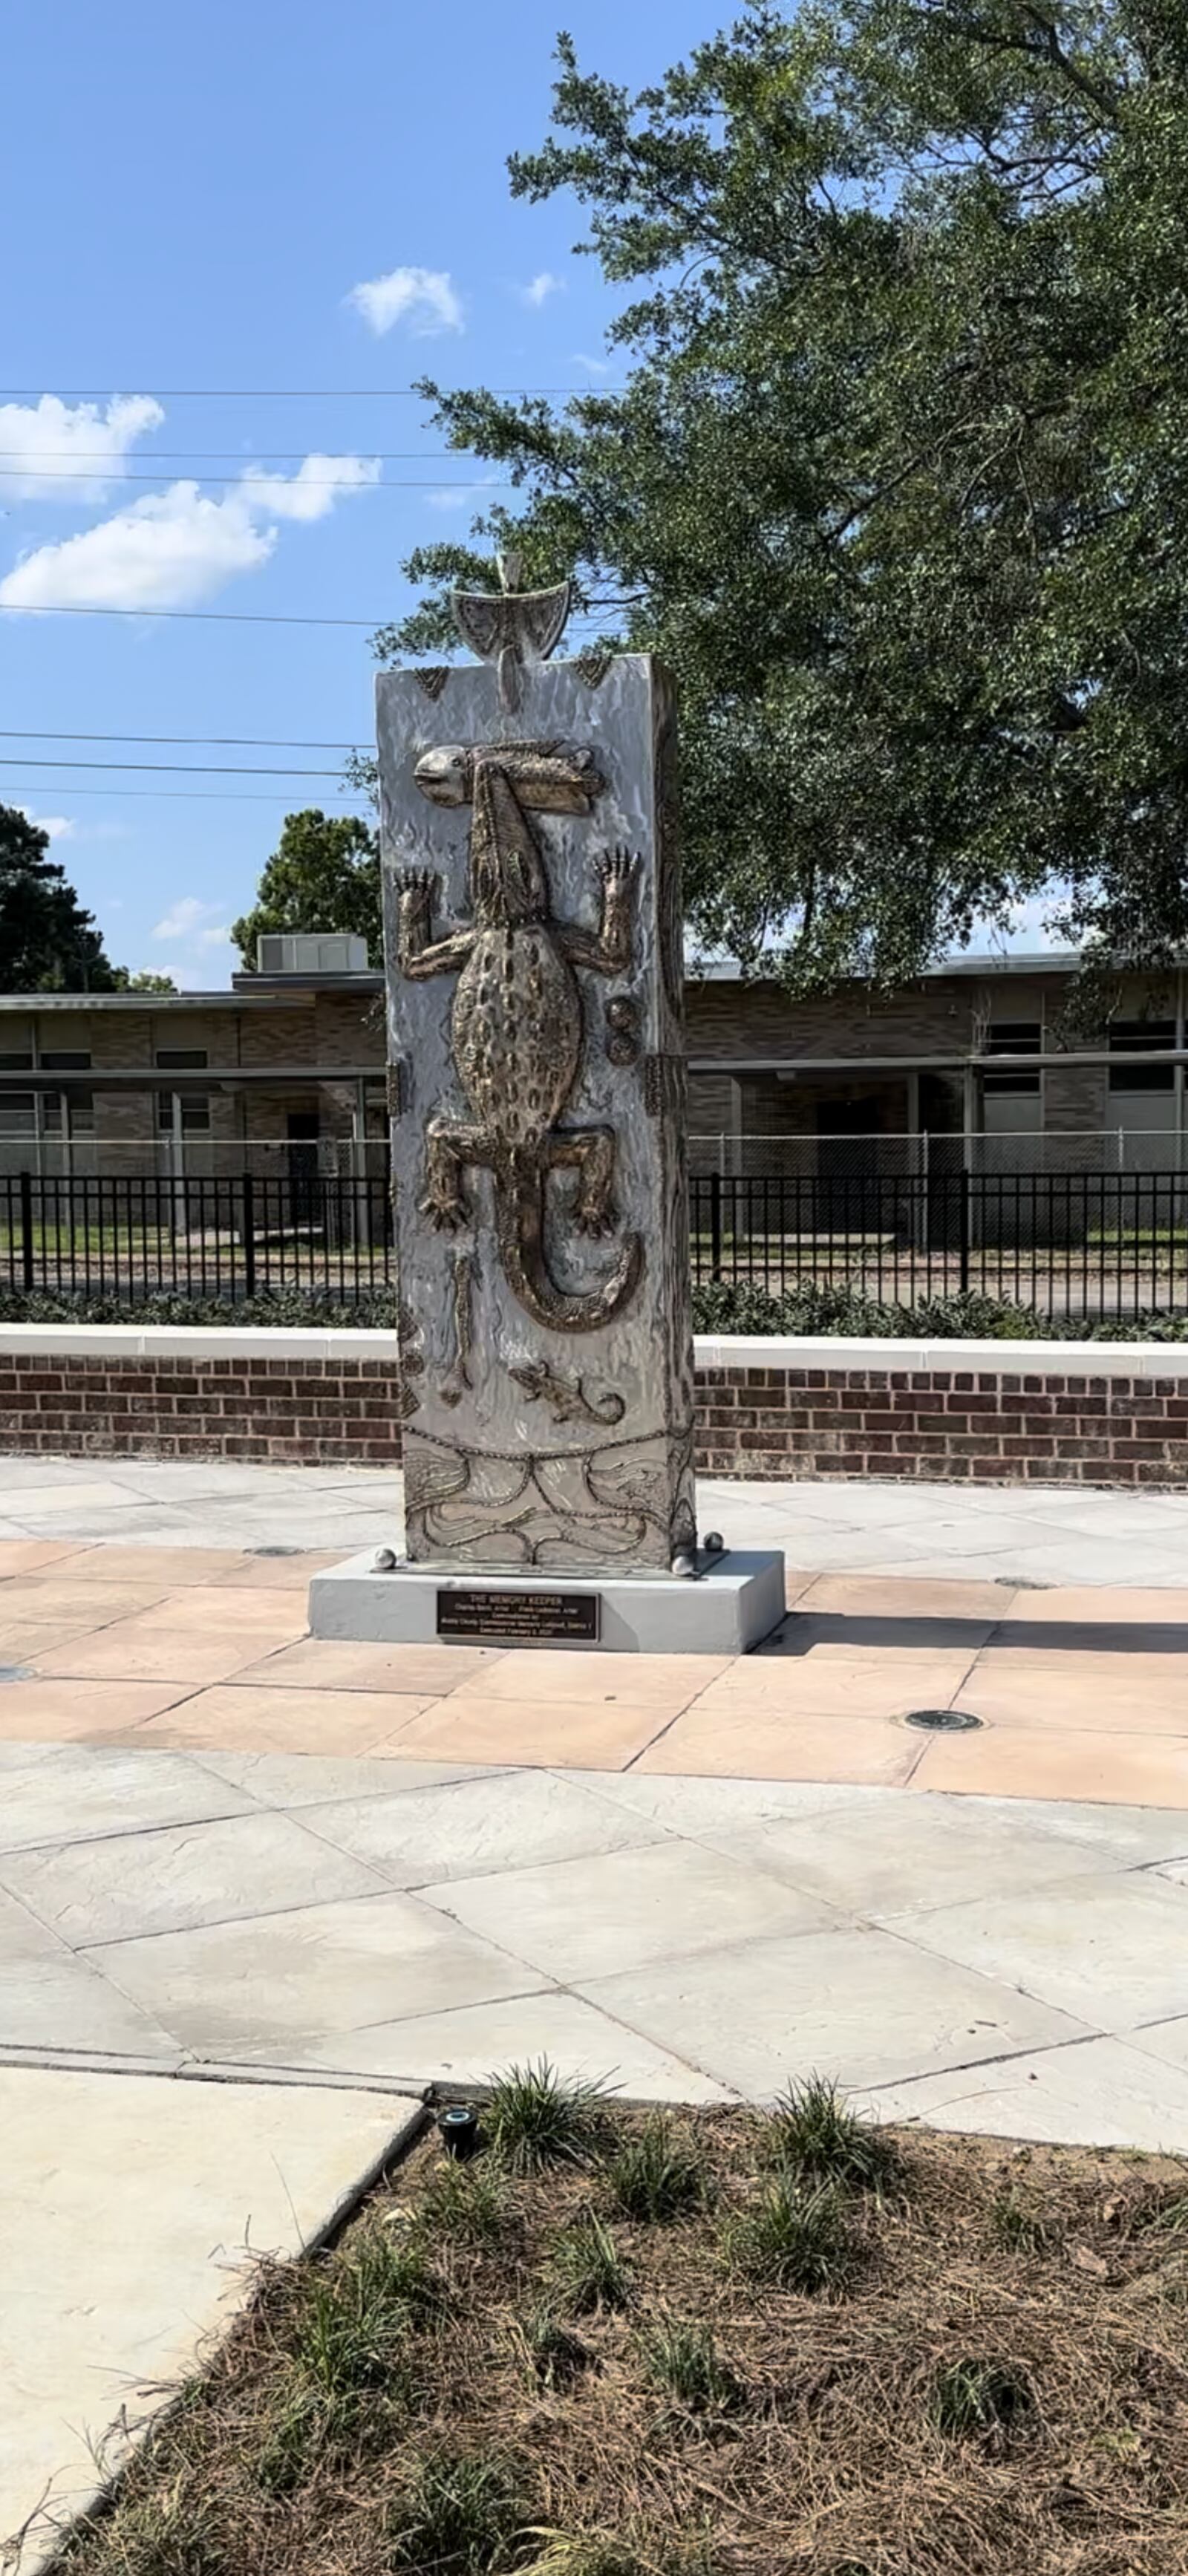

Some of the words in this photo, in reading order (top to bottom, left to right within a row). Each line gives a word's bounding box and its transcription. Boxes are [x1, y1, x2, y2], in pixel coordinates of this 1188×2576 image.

[470, 1594, 487, 1603] THE
[489, 1595, 526, 1604] MEMORY
[529, 1596, 563, 1605] KEEPER
